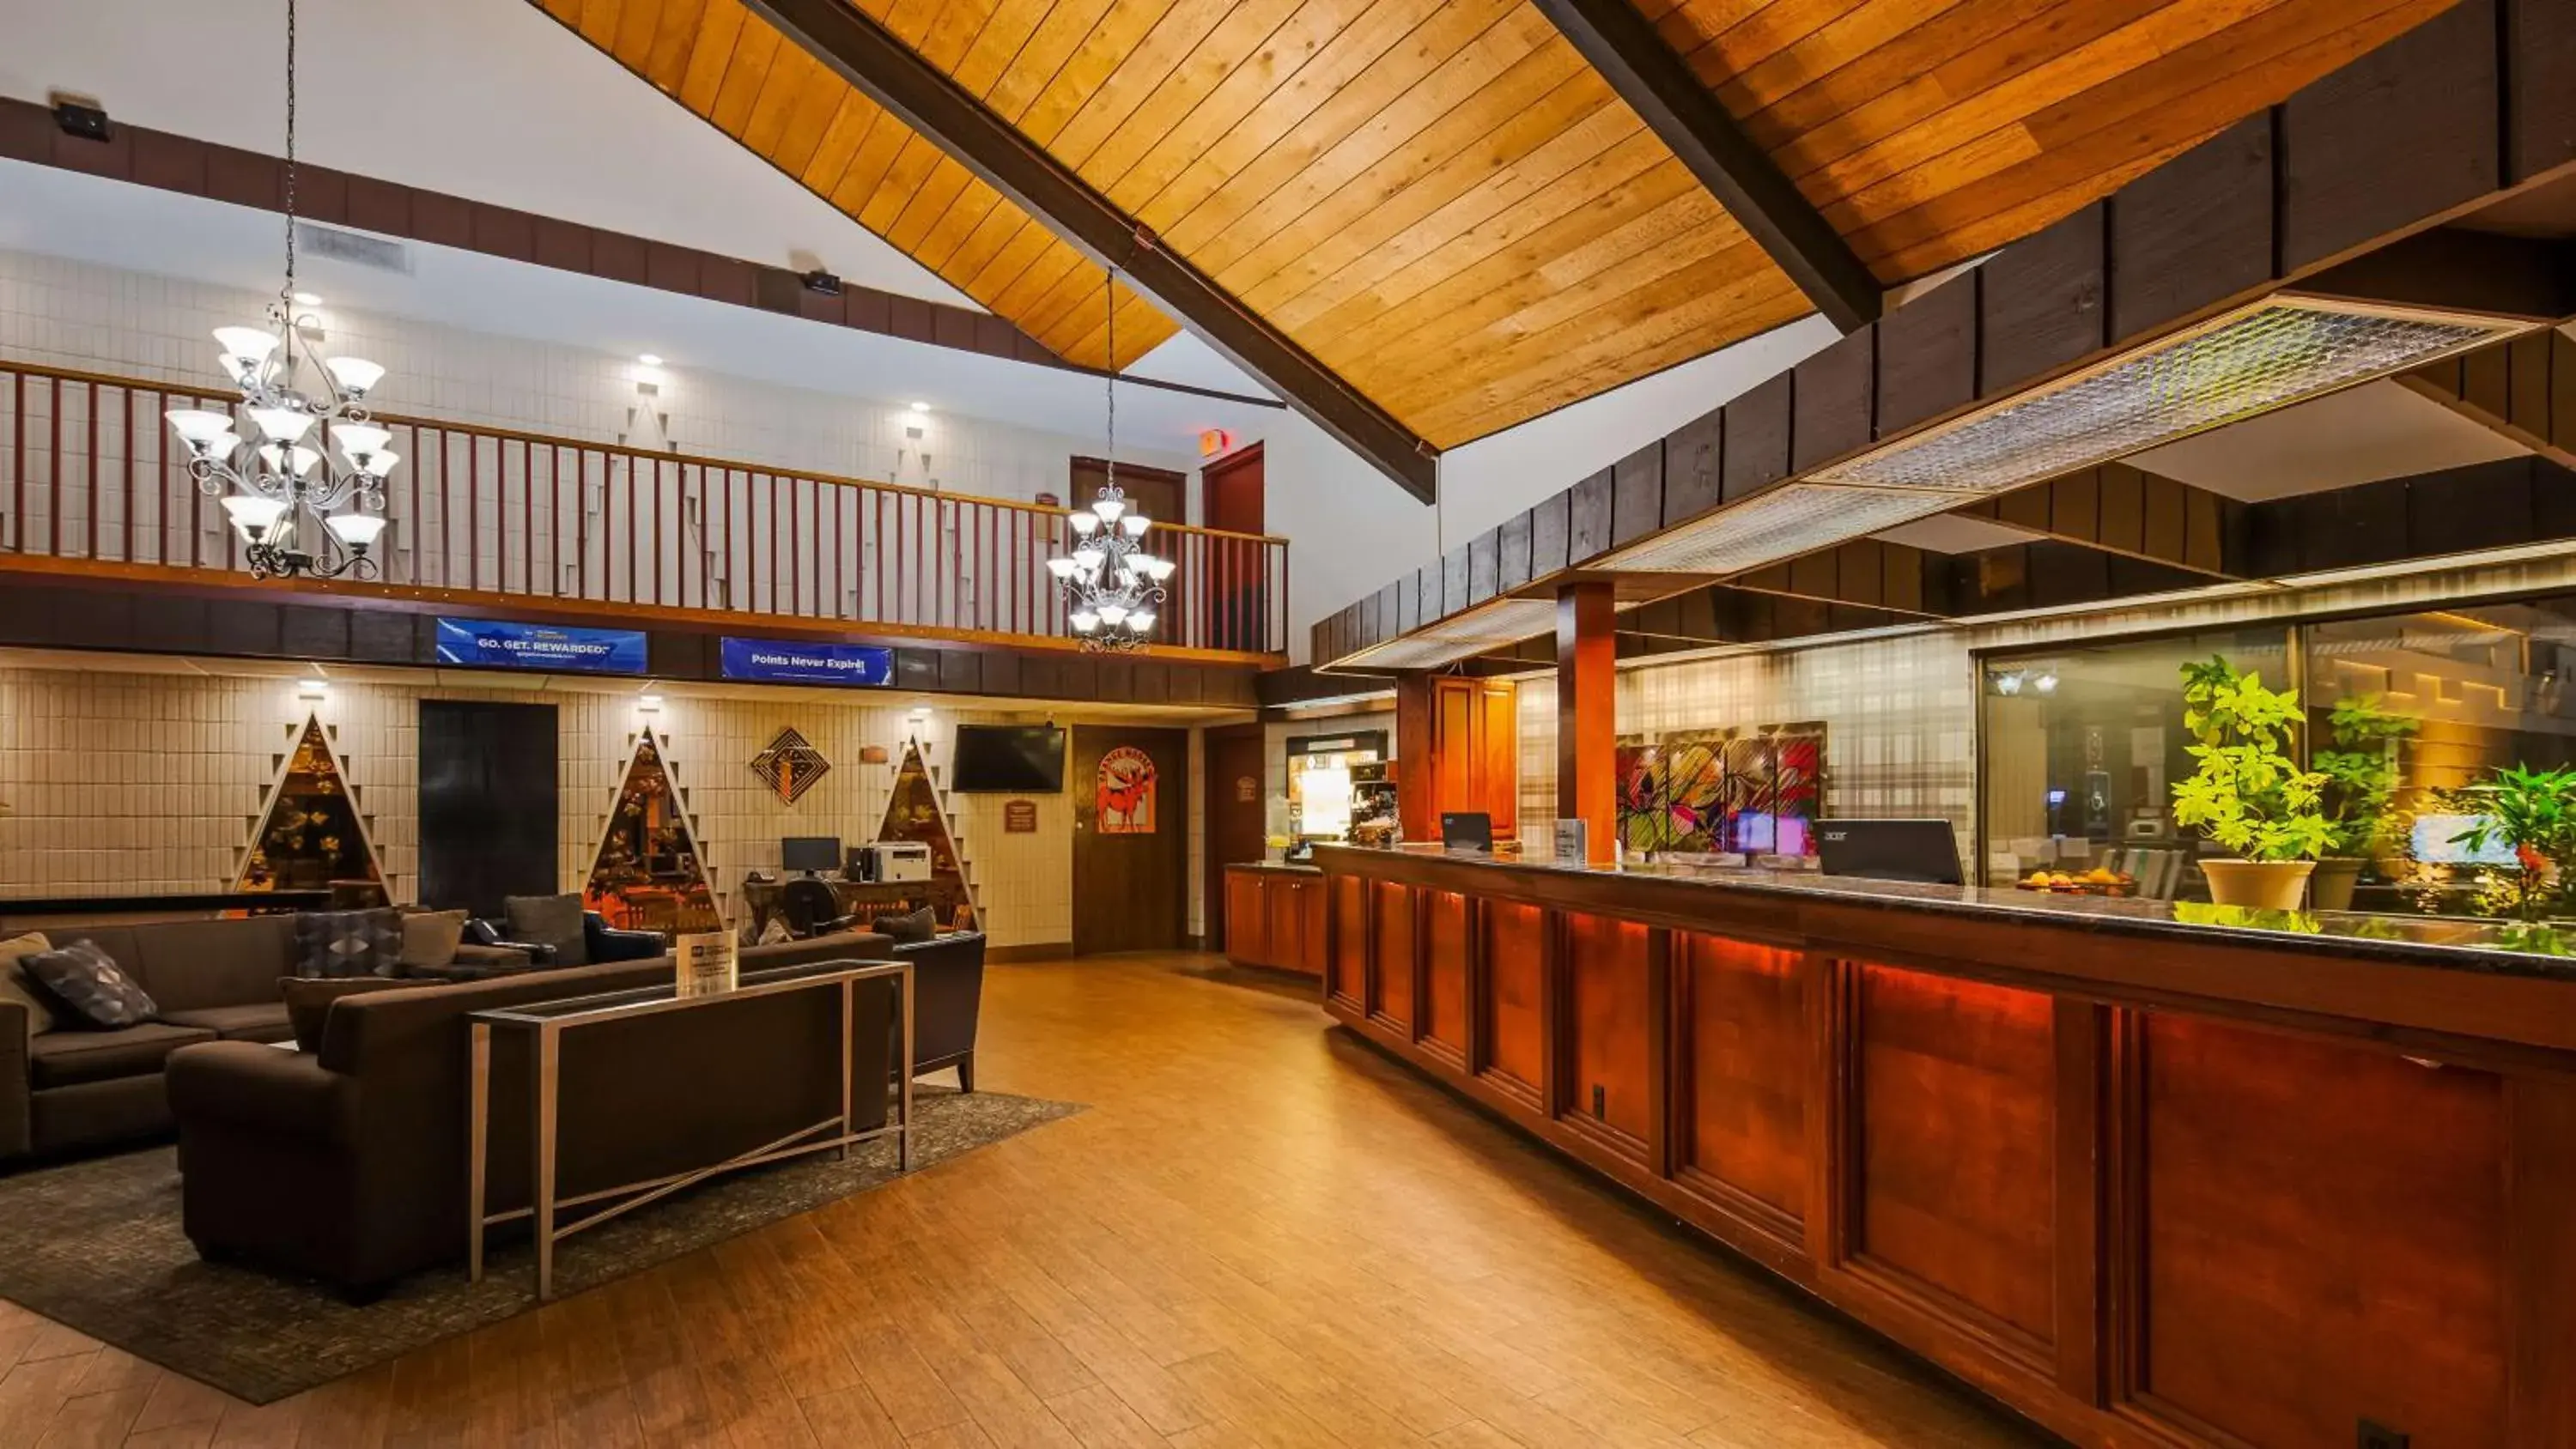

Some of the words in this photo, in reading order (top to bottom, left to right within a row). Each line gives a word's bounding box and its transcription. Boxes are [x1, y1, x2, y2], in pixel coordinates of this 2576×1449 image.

[478, 638, 501, 648] GO.
[504, 640, 531, 650] GET.
[751, 654, 788, 665] Points
[791, 657, 825, 667] Never
[1824, 832, 1848, 841] acer
